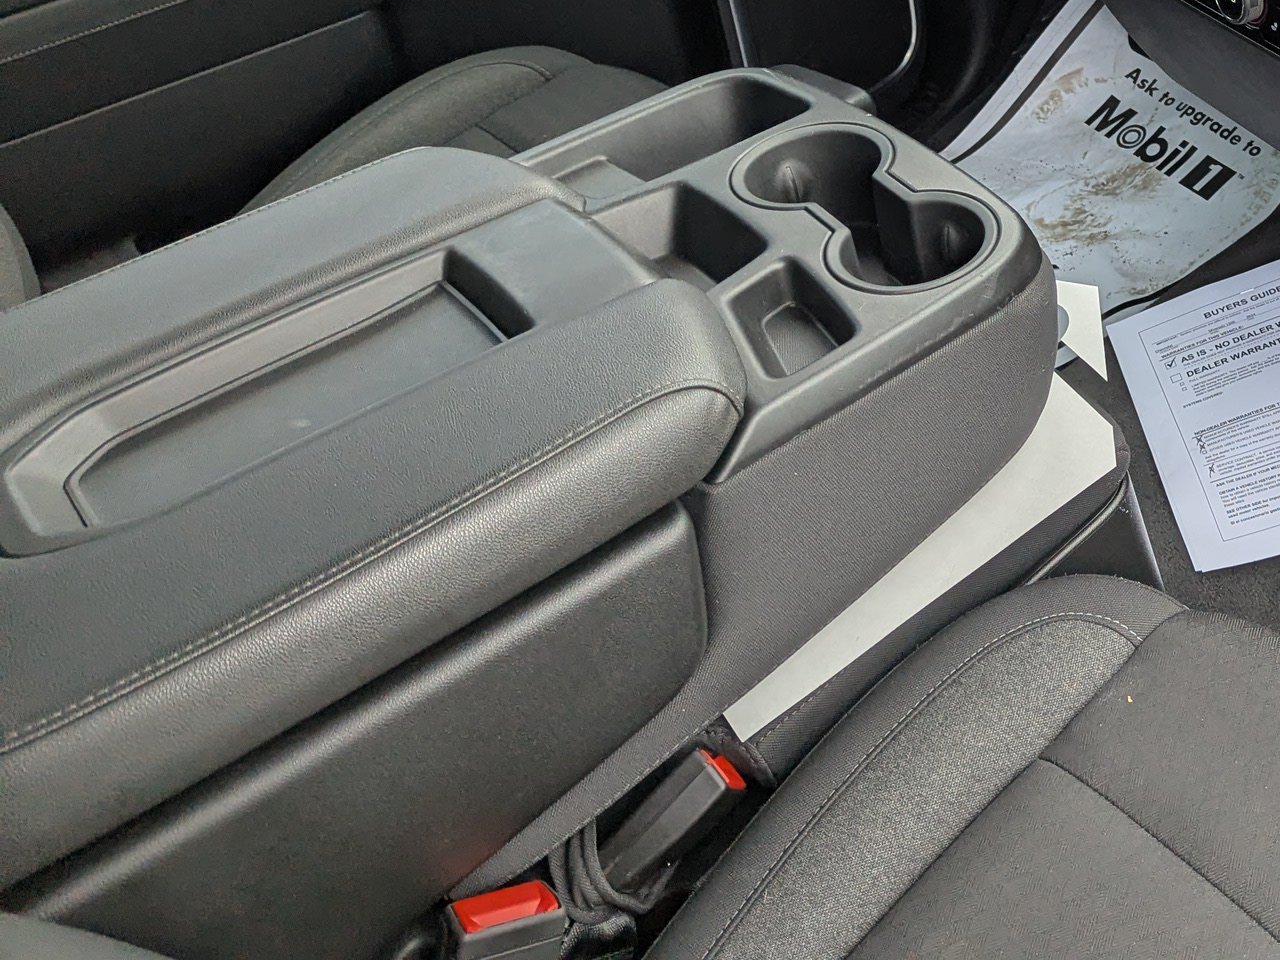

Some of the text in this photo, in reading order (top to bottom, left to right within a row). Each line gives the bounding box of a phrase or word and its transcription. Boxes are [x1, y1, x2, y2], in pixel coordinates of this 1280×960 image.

[1124, 67, 1262, 158] Ask to upgrade to
[1083, 94, 1198, 178] Mobil
[1202, 297, 1248, 319] BUYERS
[1179, 353, 1194, 363] AS
[1195, 348, 1207, 357] IS
[1213, 339, 1231, 350] NO
[1231, 323, 1274, 343] DEALER
[1185, 356, 1229, 377] DEALER
[1227, 407, 1263, 423] WARRANTIES
